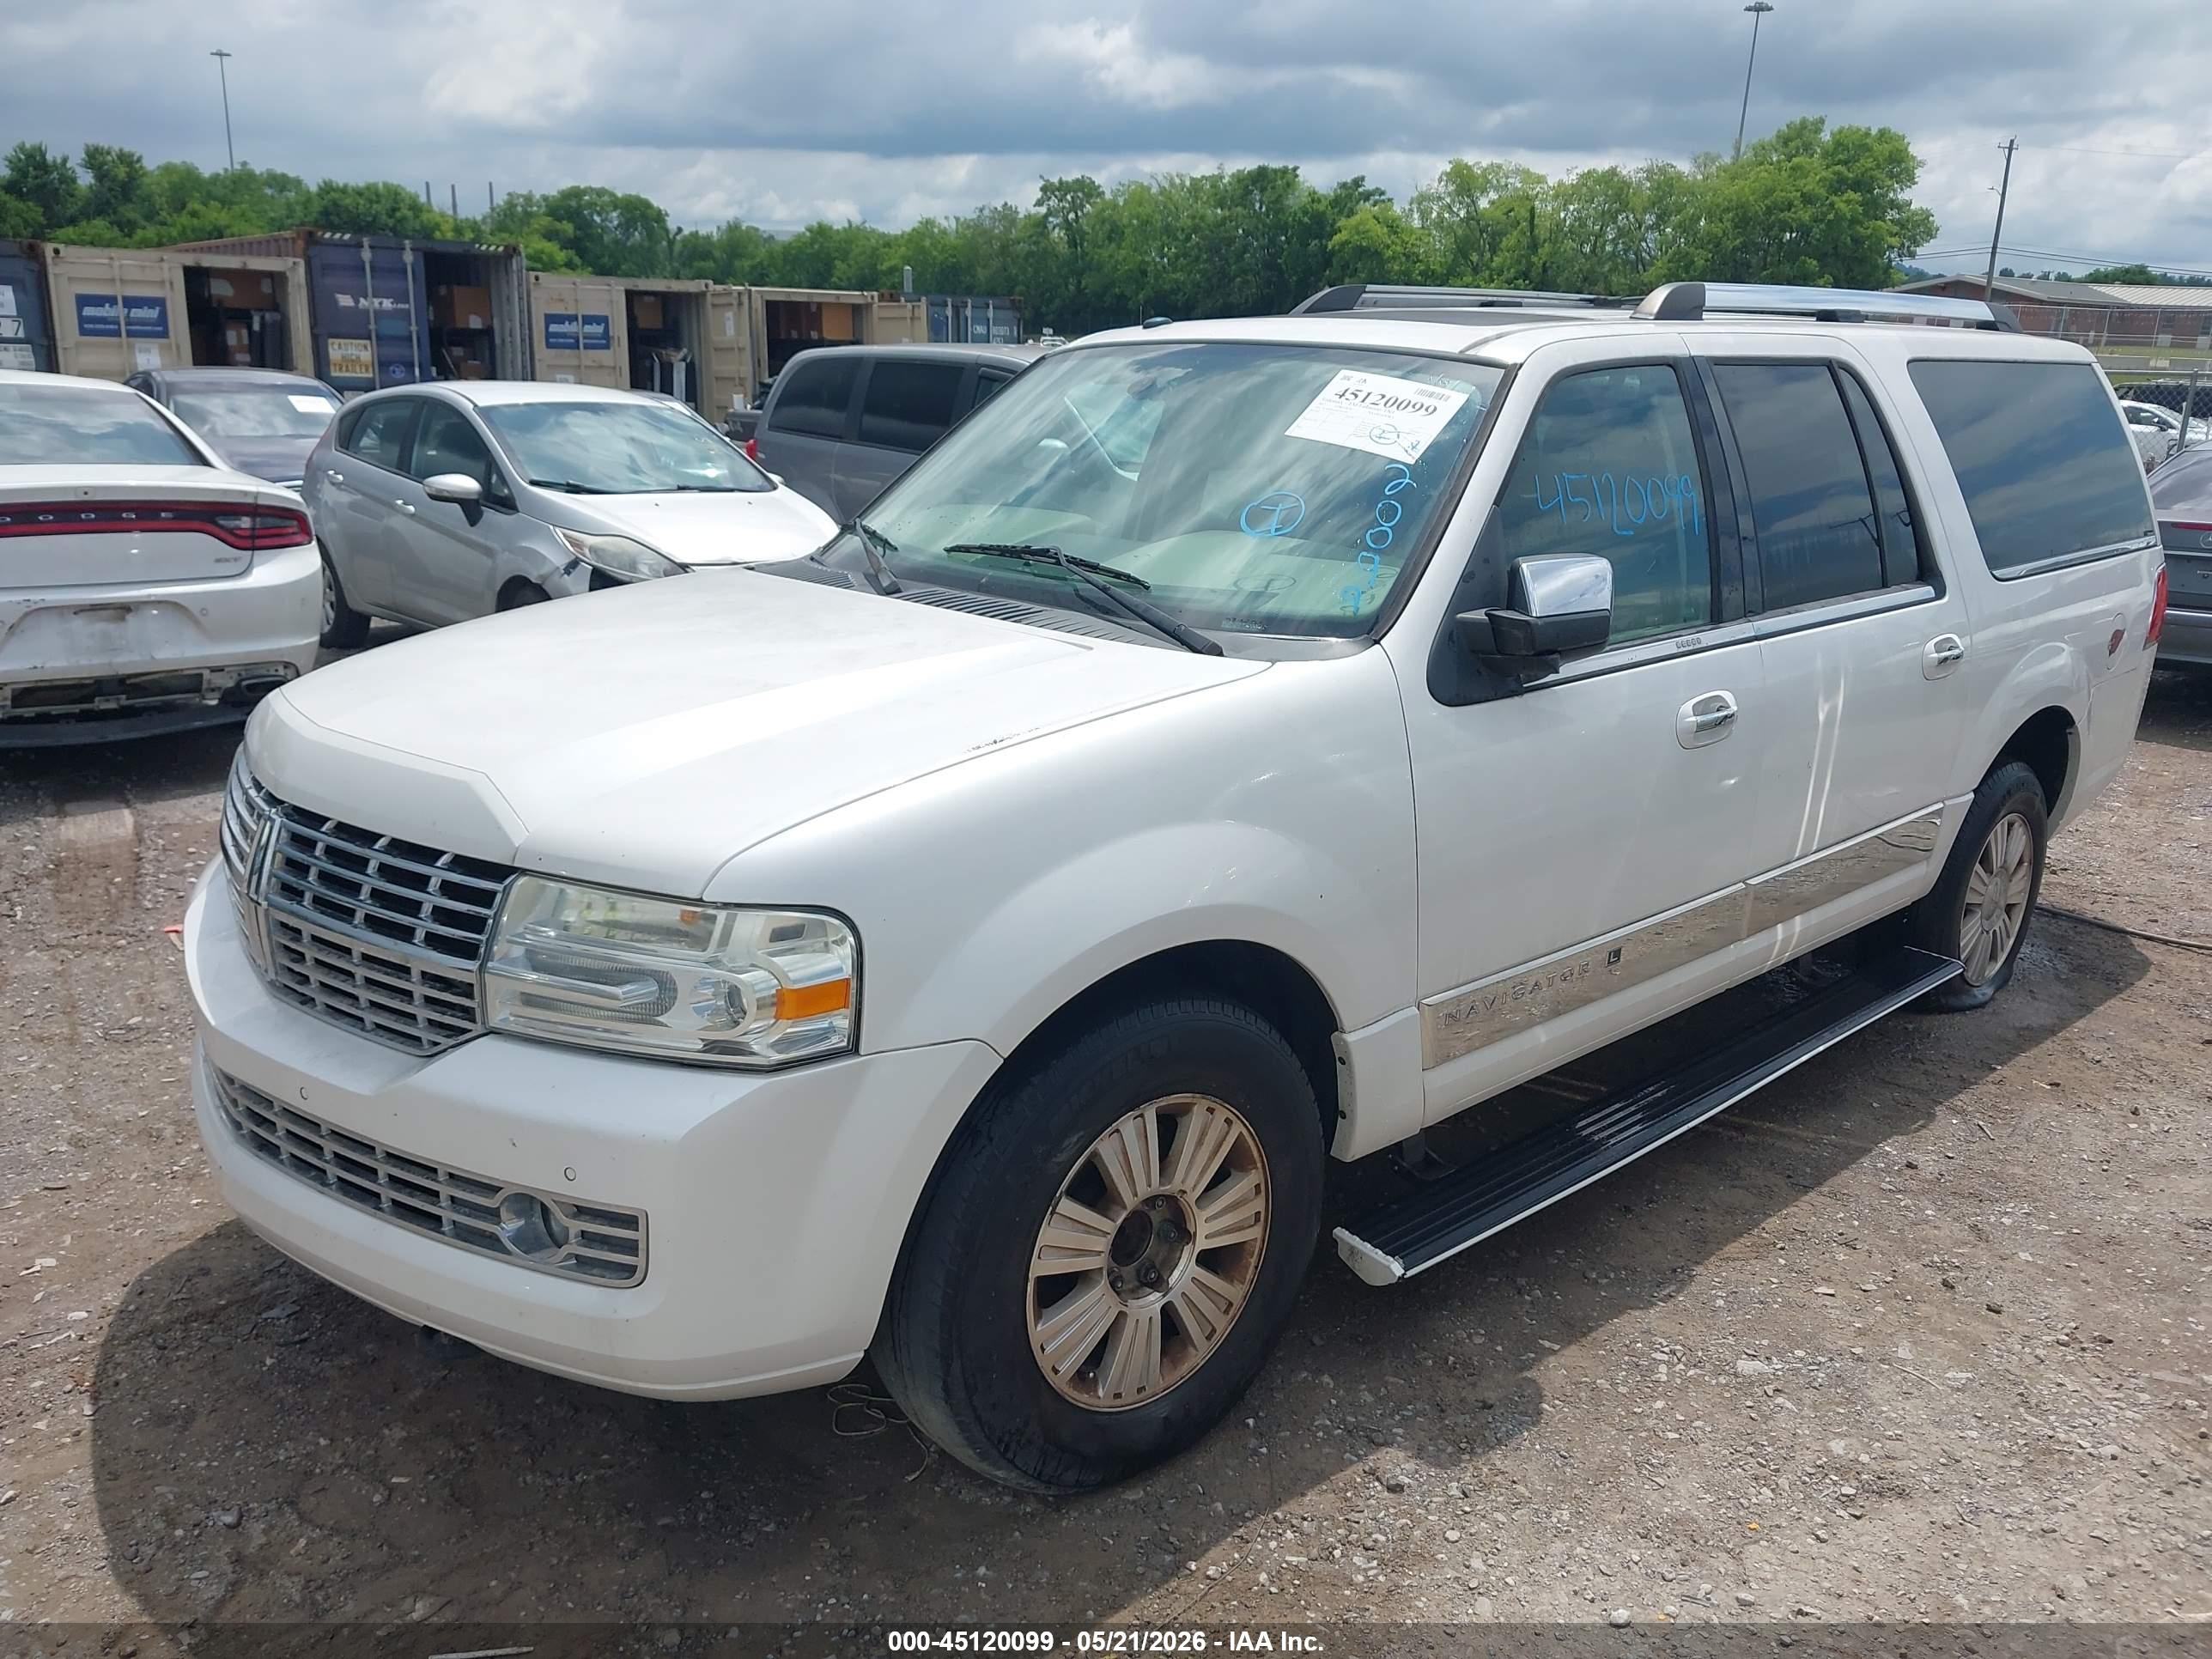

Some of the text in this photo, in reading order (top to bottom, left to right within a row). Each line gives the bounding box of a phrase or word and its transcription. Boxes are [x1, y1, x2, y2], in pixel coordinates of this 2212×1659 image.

[82, 303, 128, 317] mobie
[330, 342, 370, 352] CAUTION
[332, 362, 371, 374] TRAILER
[1334, 386, 1438, 417] 45120099
[1534, 473, 1699, 536] 45120099
[0, 512, 174, 522] DODGE
[1443, 951, 1620, 1026] NAVIGATOR L
